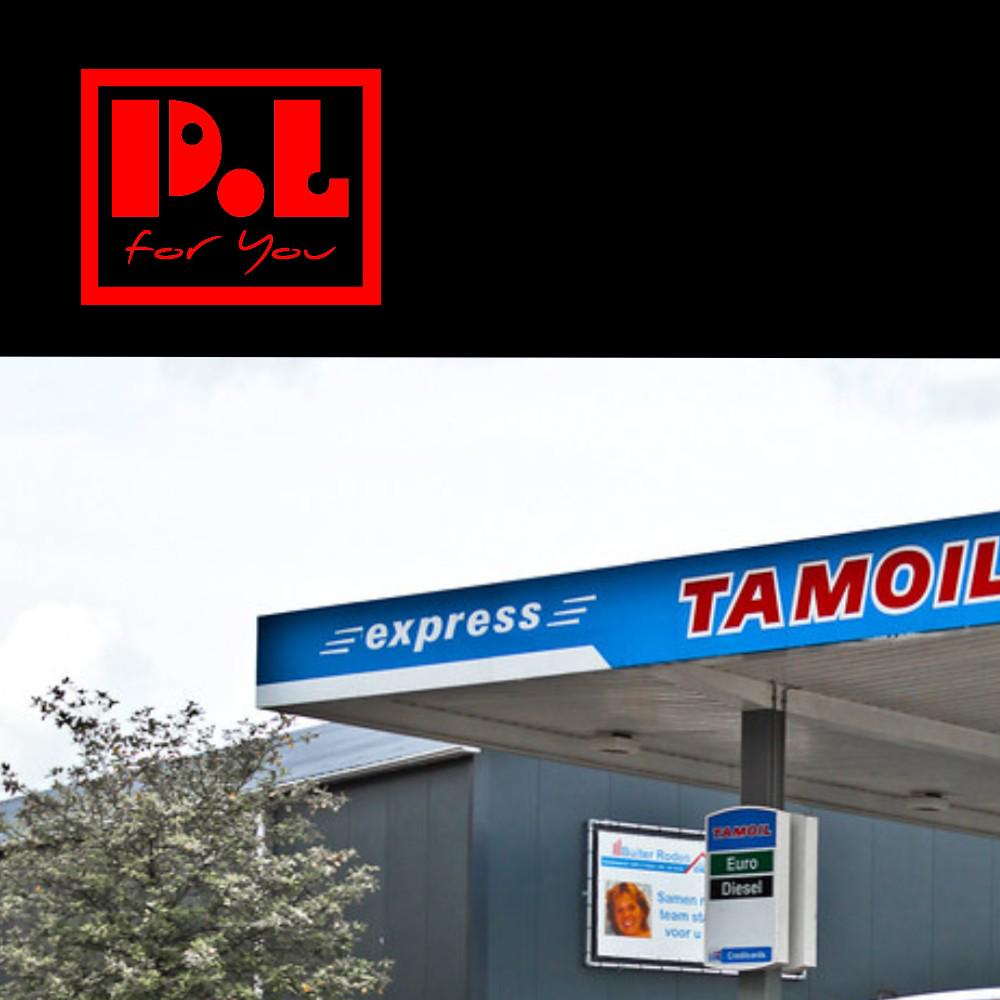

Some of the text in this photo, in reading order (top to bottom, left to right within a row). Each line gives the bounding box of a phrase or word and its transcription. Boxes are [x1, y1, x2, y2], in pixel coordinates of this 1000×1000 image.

[365, 602, 542, 653] express
[713, 823, 772, 838] TAMOIL
[726, 856, 759, 871] Euro
[721, 880, 763, 896] Diesel
[656, 890, 698, 906] Samen
[660, 909, 689, 921] team
[665, 928, 691, 939] voor
